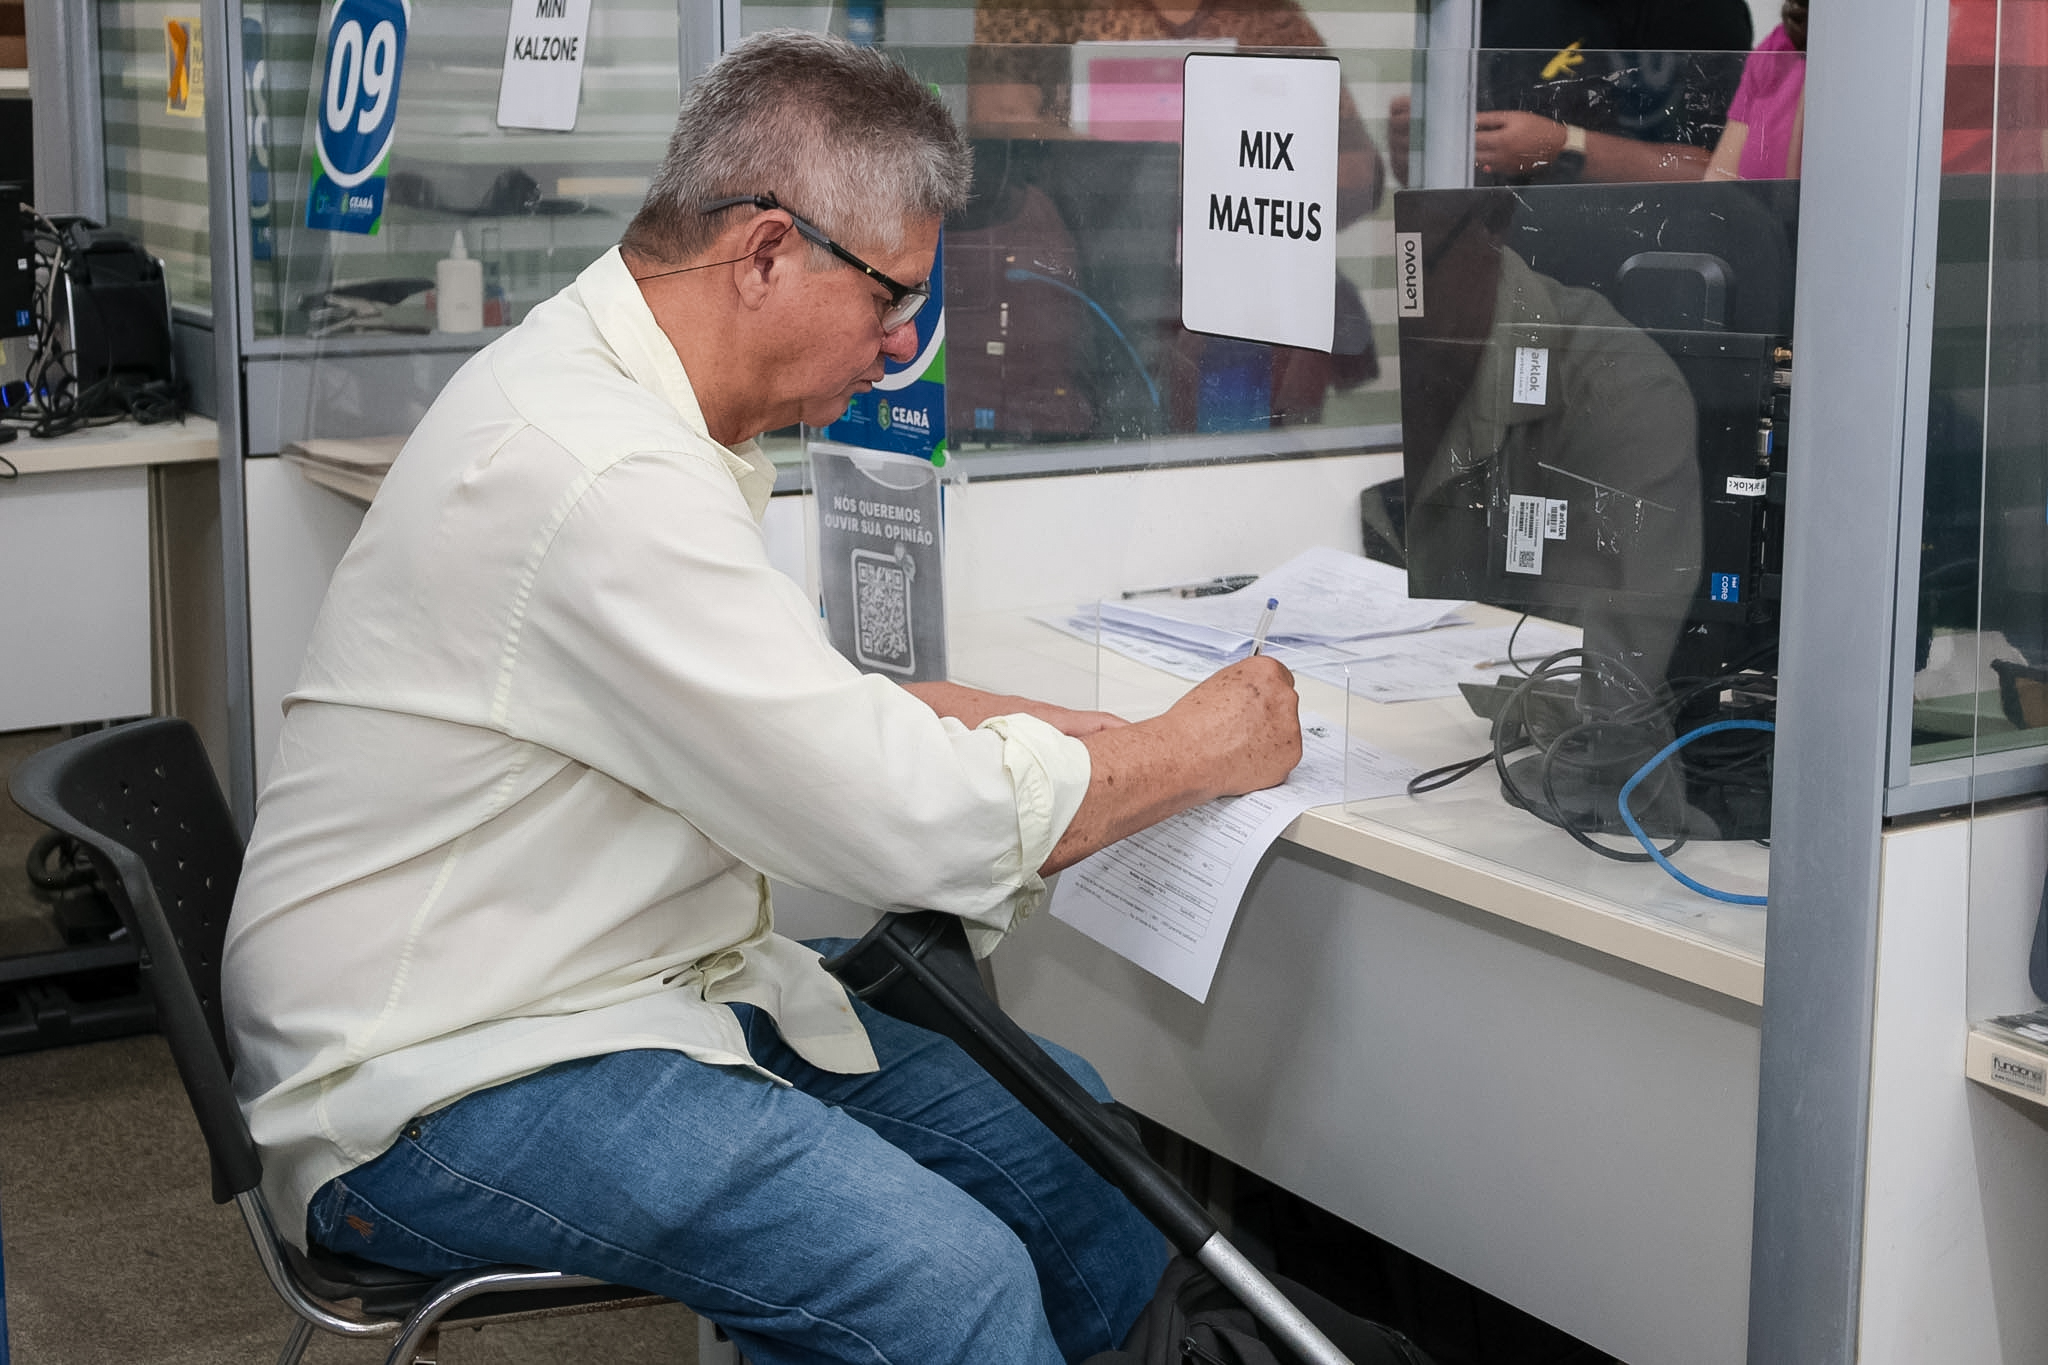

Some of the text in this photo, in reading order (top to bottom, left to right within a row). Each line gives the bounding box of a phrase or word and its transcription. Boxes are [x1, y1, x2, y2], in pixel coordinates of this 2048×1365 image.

[536, 0, 567, 18] MINI
[513, 35, 578, 61] KALZONE
[326, 19, 397, 135] 09
[1239, 130, 1295, 171] MIX
[1209, 193, 1322, 242] MATEUS
[1404, 240, 1418, 310] Lenovo
[1528, 351, 1541, 392] arklok
[892, 406, 930, 429] CEARÁ
[833, 495, 921, 524] NÓS QUEREMOS
[1558, 512, 1566, 537] arklok
[824, 513, 933, 546] OUVIR SUA OPINIÃO
